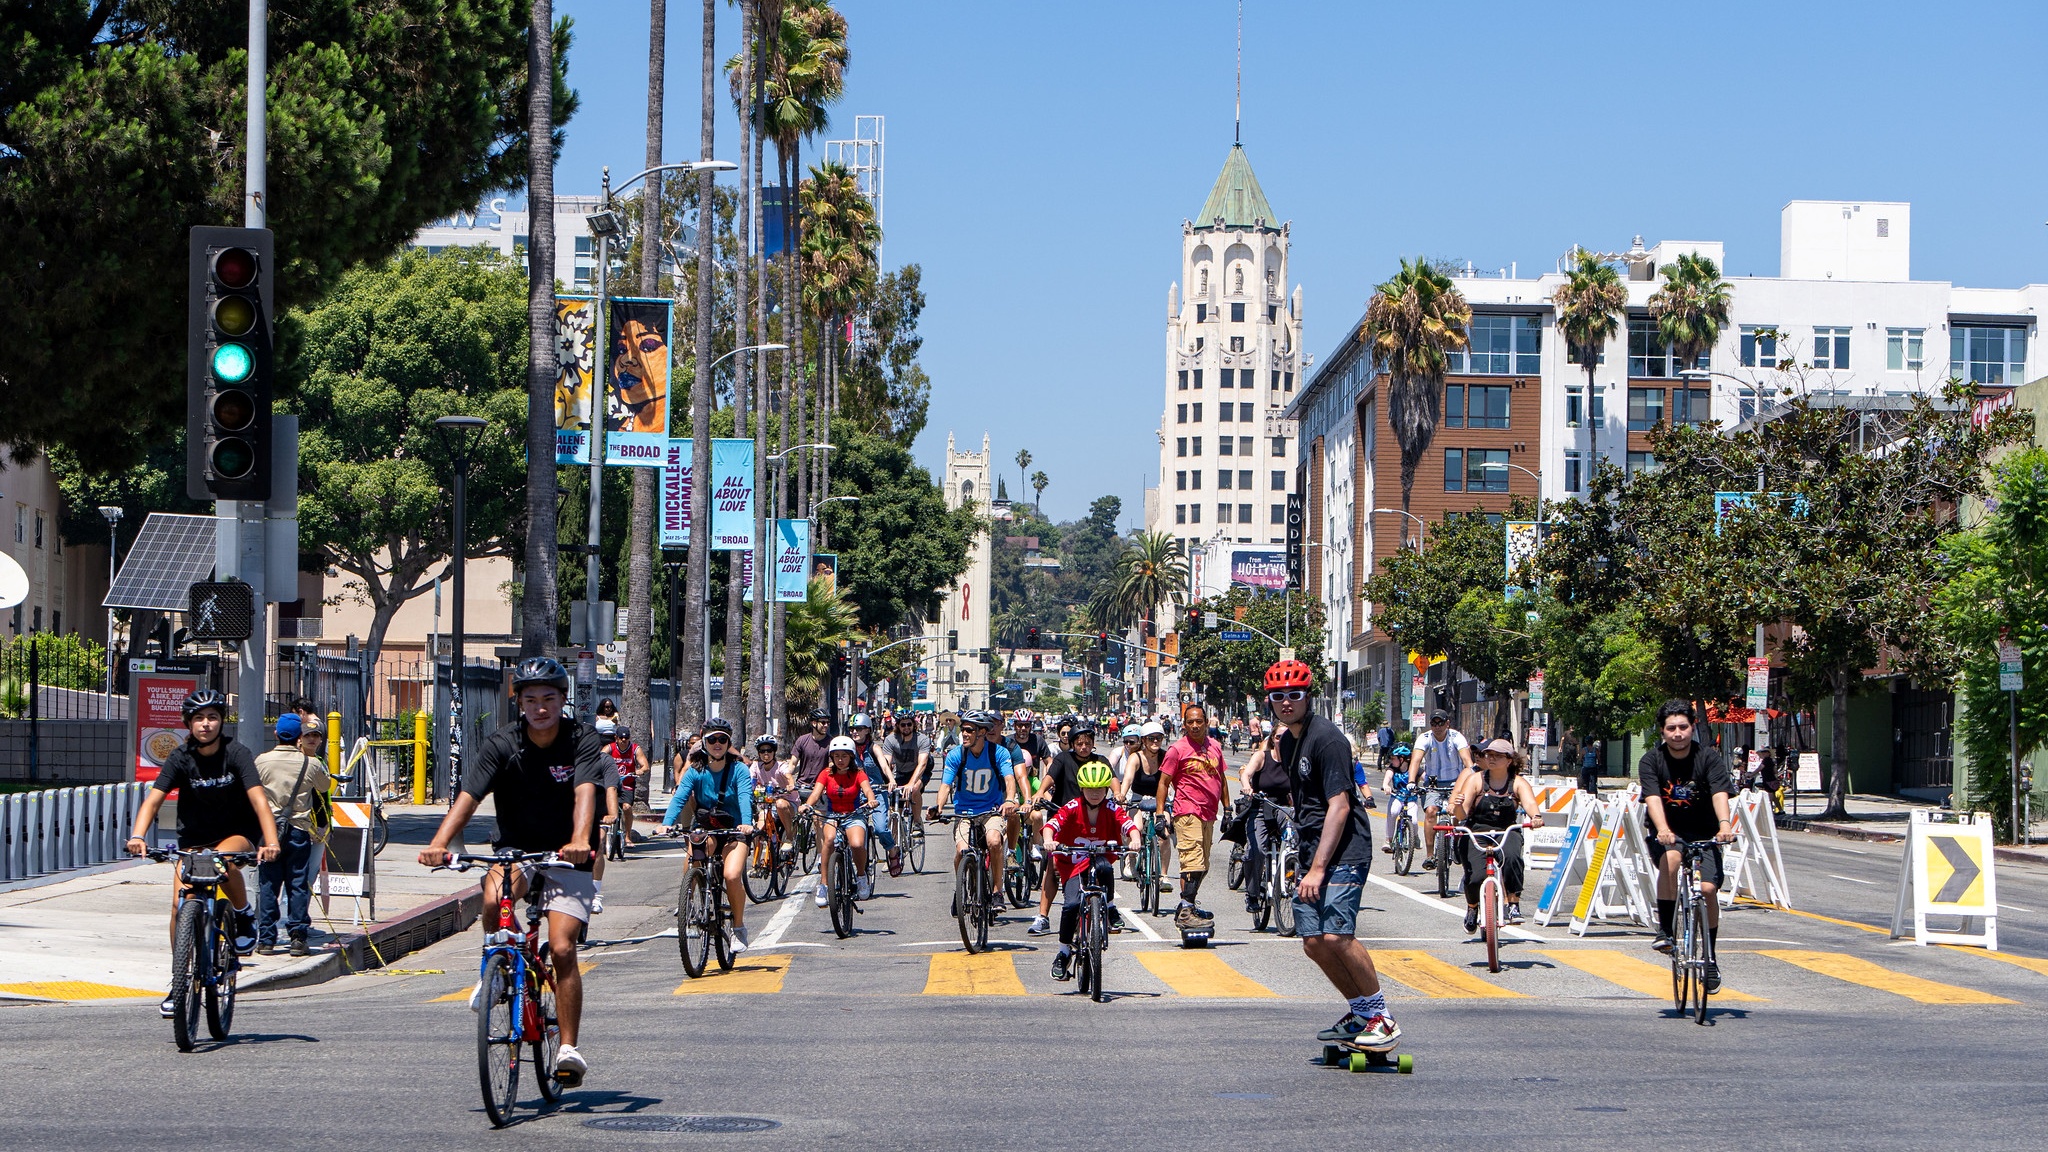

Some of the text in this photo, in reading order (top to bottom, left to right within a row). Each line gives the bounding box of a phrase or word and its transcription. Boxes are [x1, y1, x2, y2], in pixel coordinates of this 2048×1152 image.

[620, 445, 661, 458] BROAD
[723, 476, 743, 487] ALL
[665, 446, 680, 530] MICKALENE
[714, 489, 752, 499] ABOUT
[719, 501, 746, 512] LOVE
[722, 536, 749, 544] BROAD
[1289, 498, 1300, 585] MODERA
[782, 565, 801, 573] LOVE
[964, 768, 992, 794] 10
